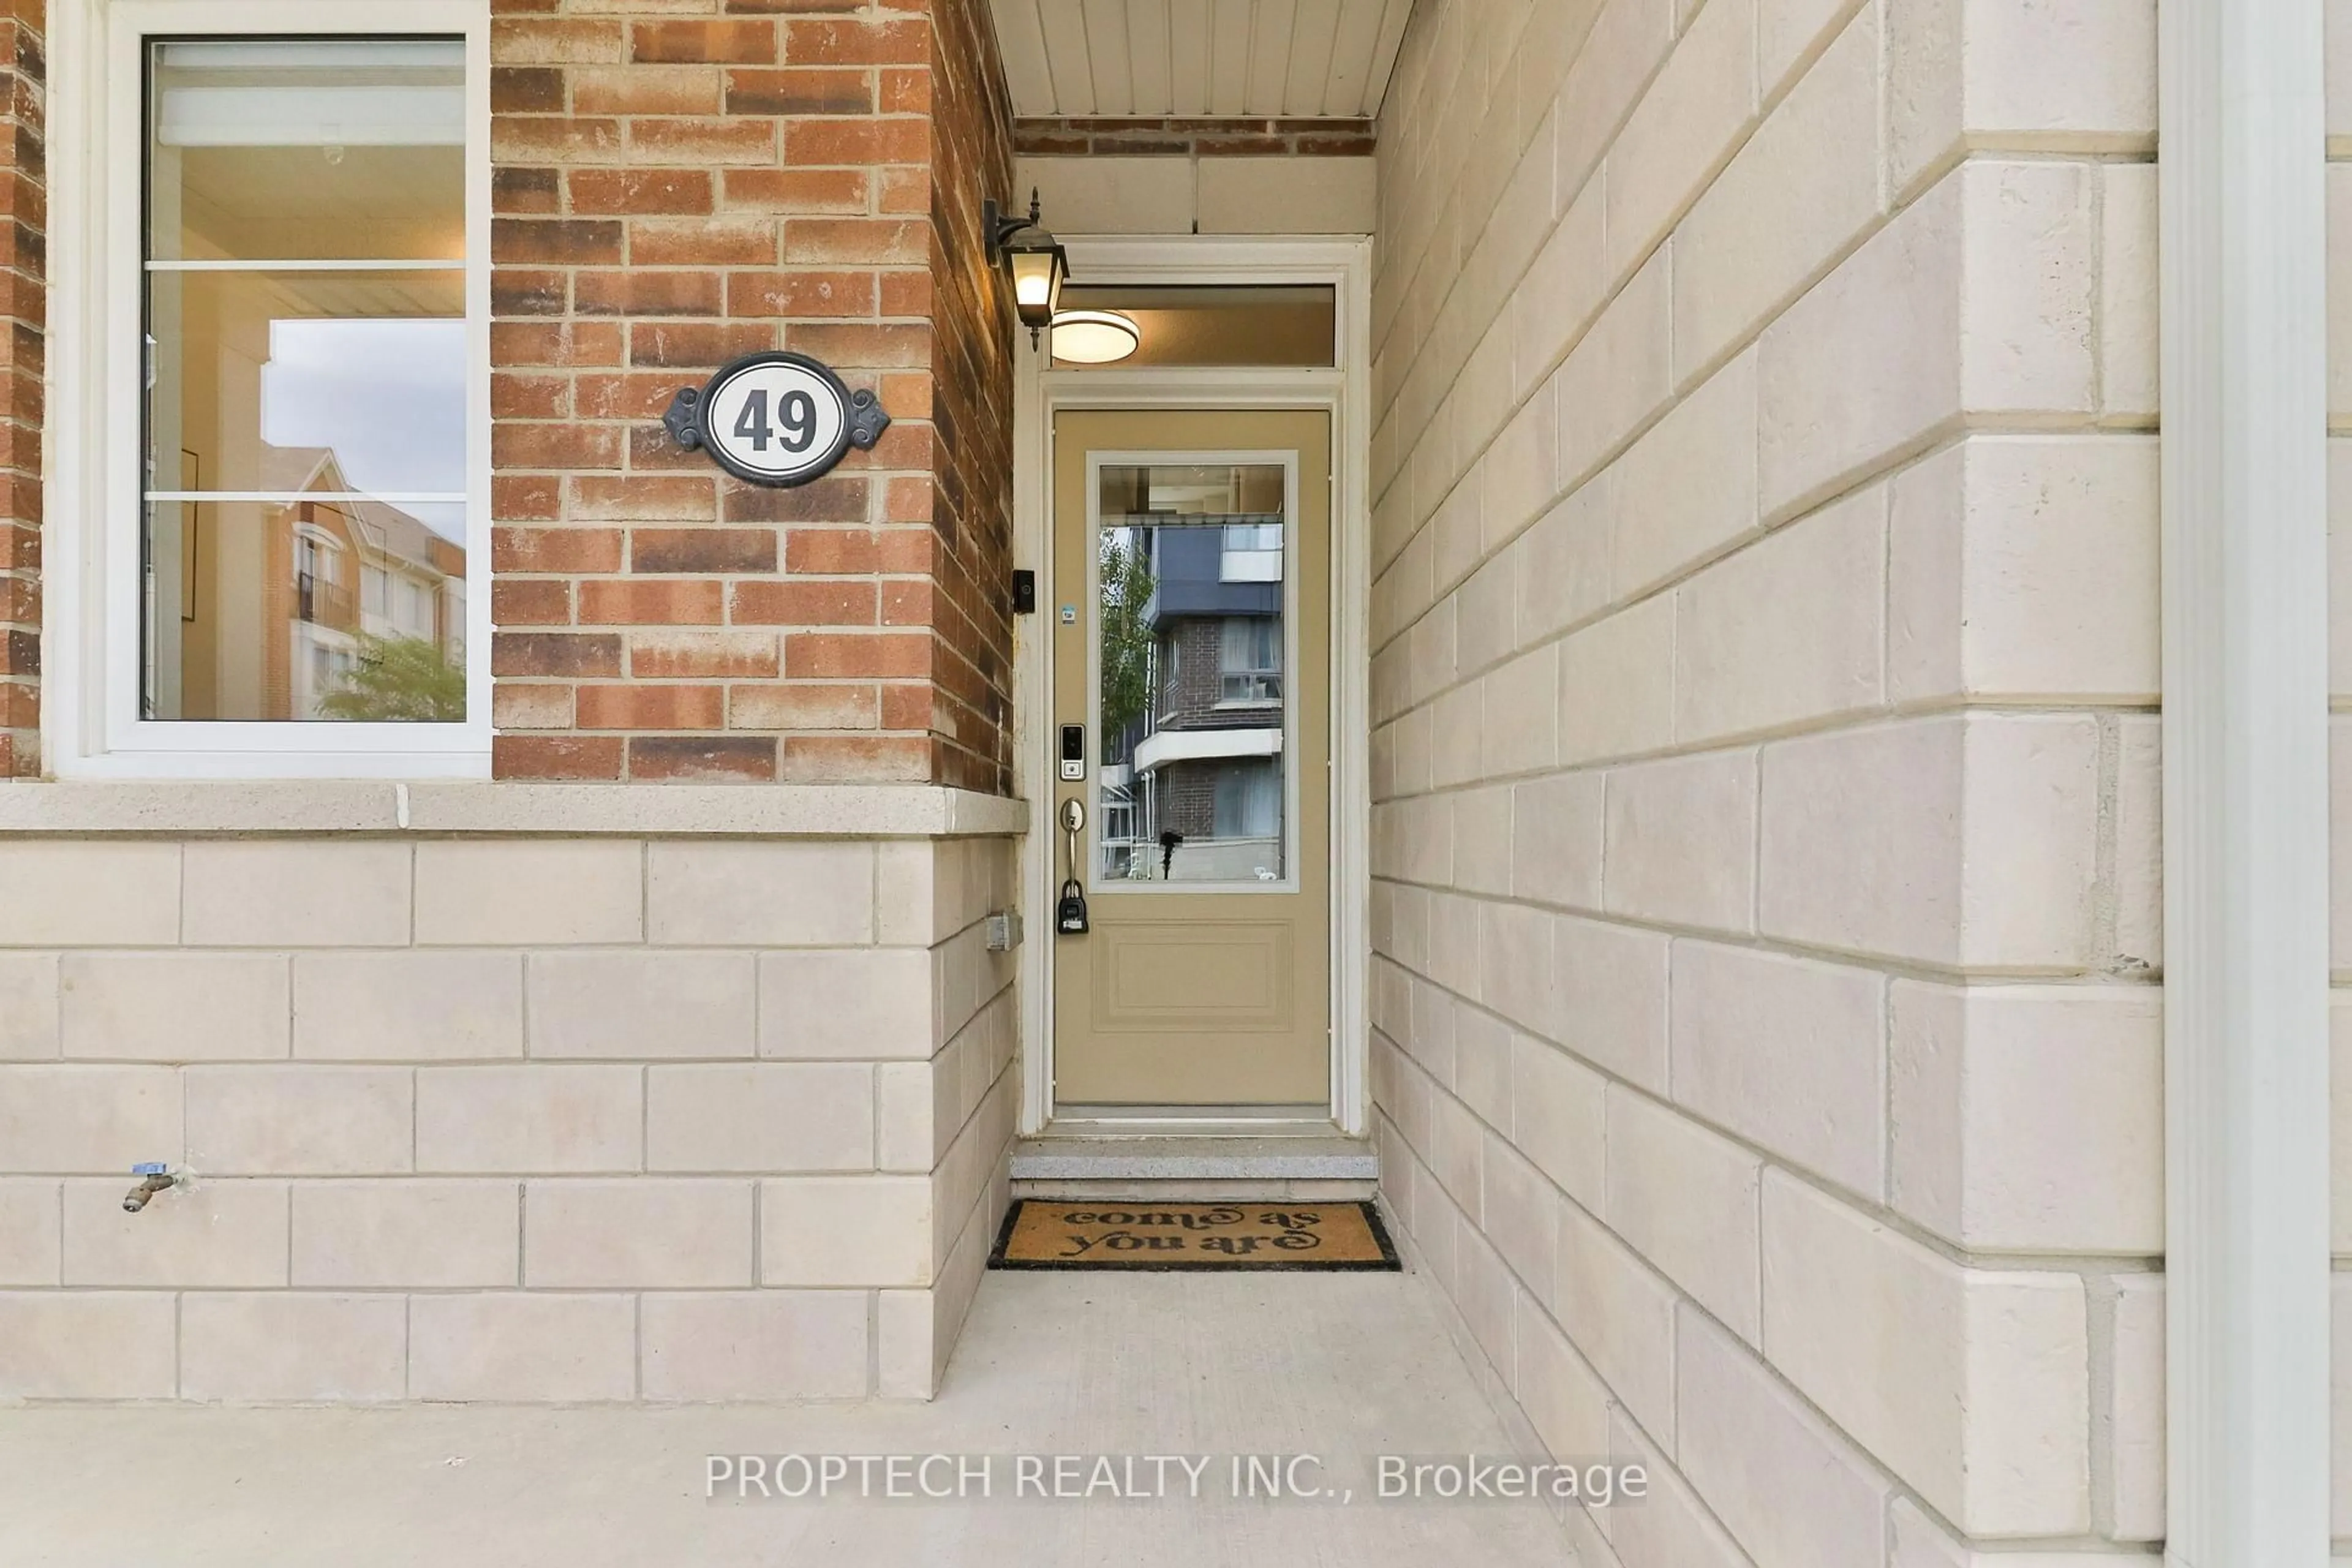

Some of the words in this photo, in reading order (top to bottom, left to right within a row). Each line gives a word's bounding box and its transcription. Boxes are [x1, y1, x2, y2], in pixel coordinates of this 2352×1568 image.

[734, 389, 816, 453] 49
[1064, 1208, 1245, 1229] come
[1259, 1212, 1321, 1229] as
[1059, 1231, 1186, 1256] you
[1199, 1230, 1321, 1255] are
